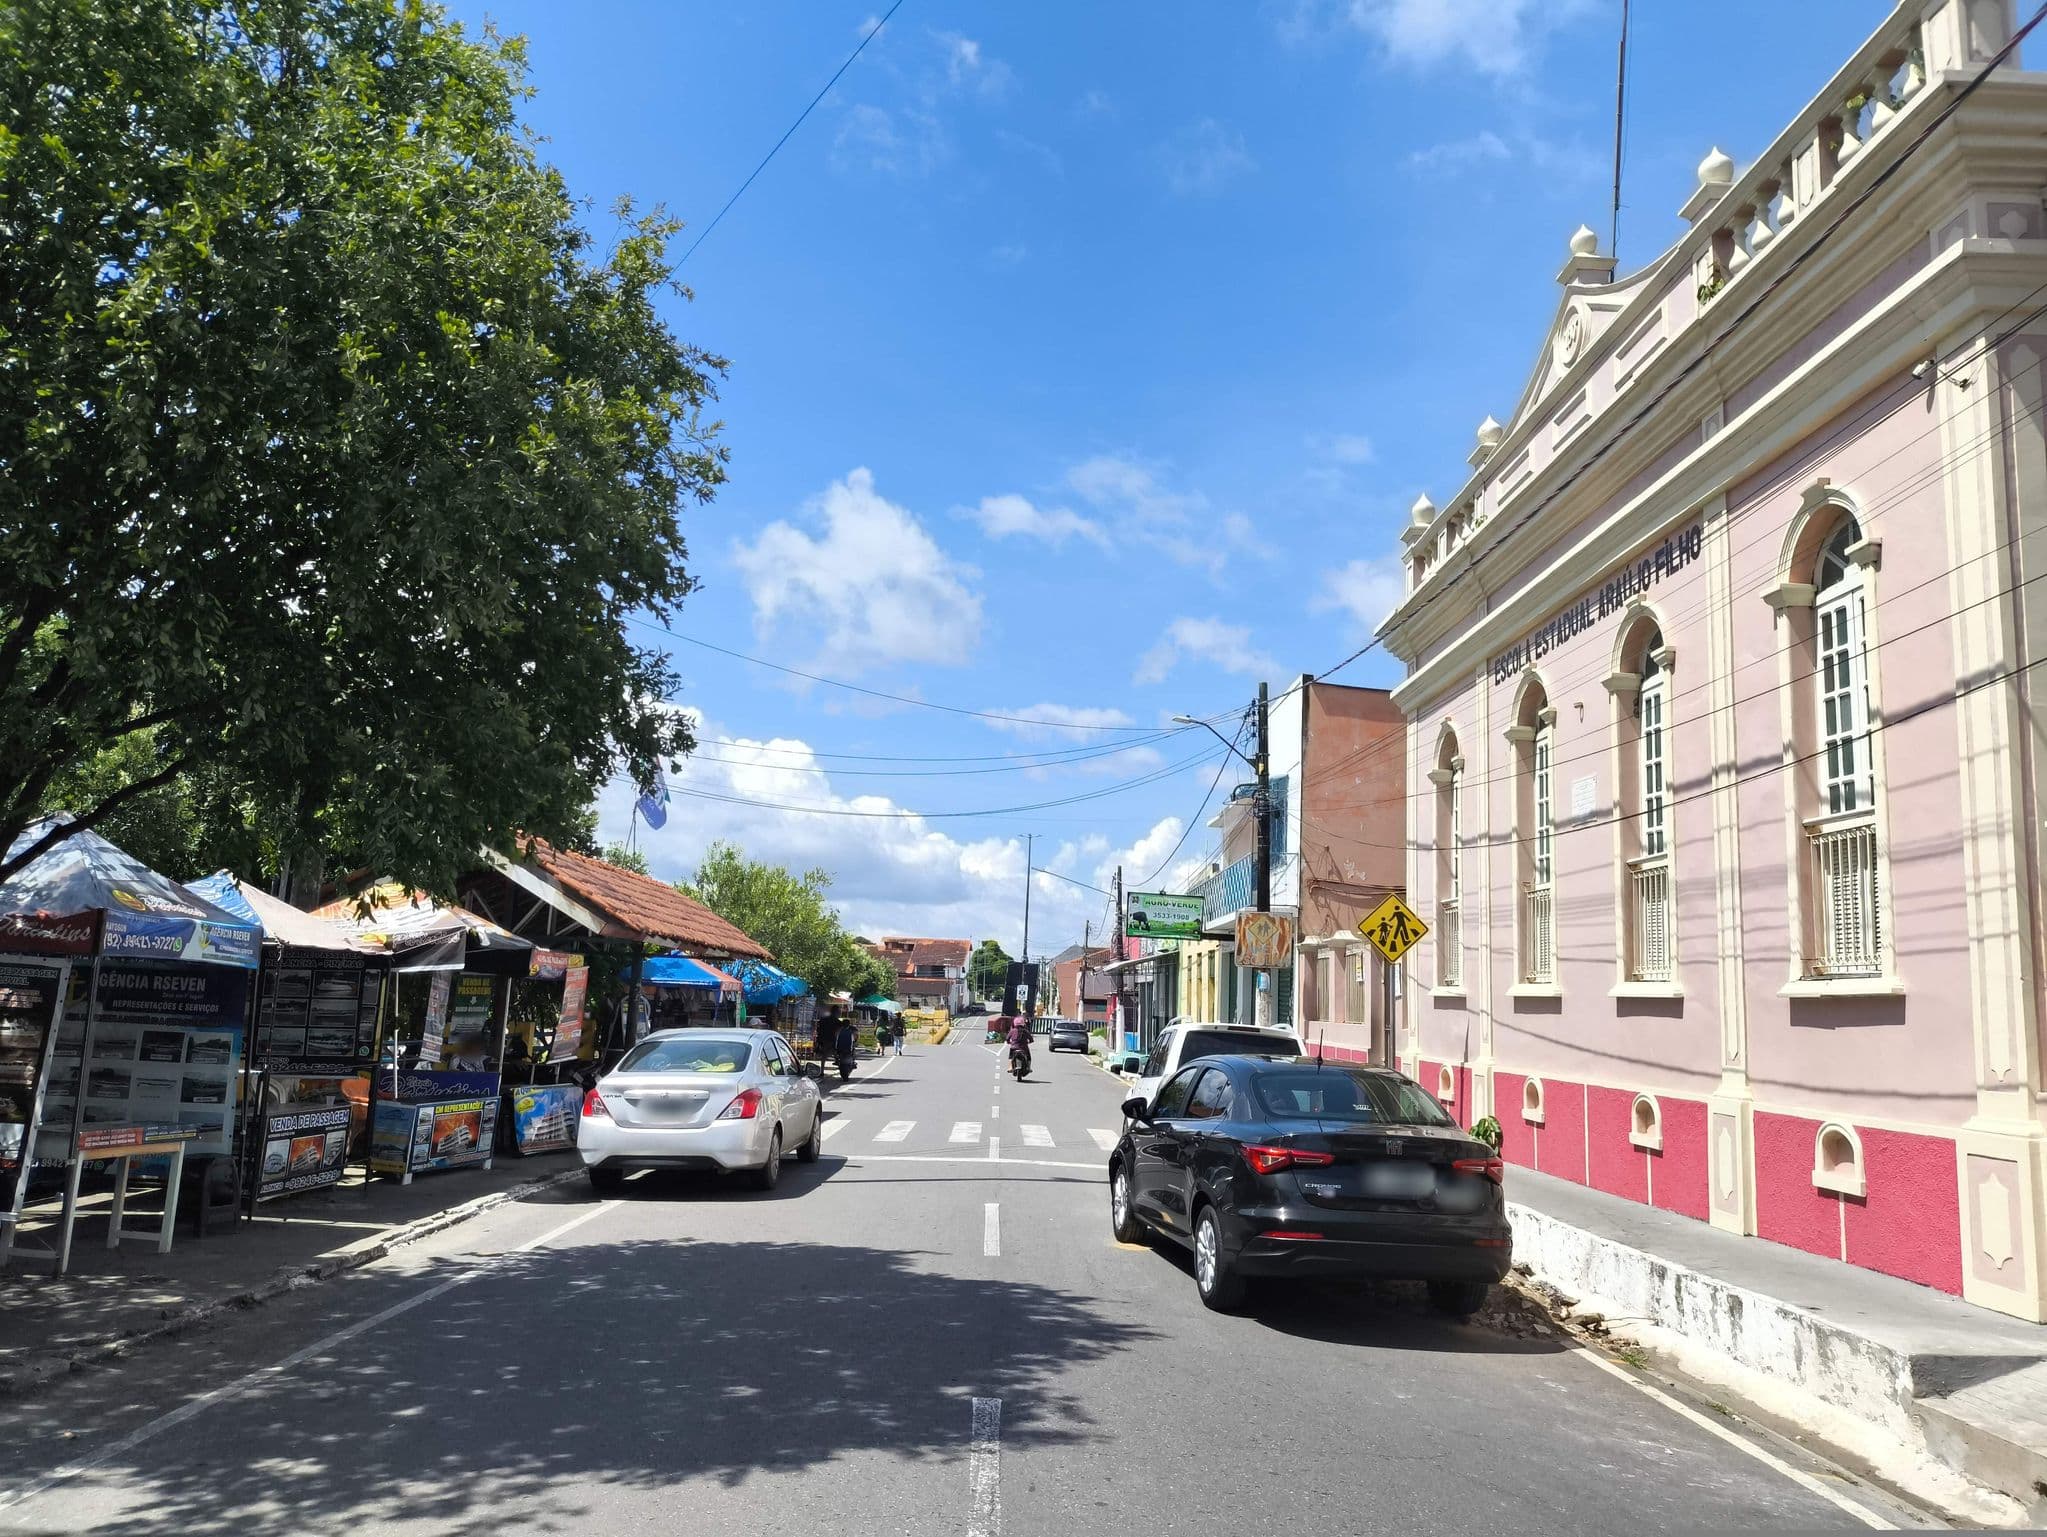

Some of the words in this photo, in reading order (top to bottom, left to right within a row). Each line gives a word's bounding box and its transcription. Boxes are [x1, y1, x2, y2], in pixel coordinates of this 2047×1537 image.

[1494, 639, 1532, 686] ESCOLA
[1534, 598, 1596, 660] ESTADUAL
[1597, 558, 1651, 621] ARAÚJO
[98, 972, 148, 991] GÊNCIA
[152, 975, 207, 992] RSEVEN
[112, 999, 176, 1012] REPRESENTAÇÕES
[178, 1003, 183, 1011] E
[184, 1003, 220, 1014] SERVIÇOS
[269, 1115, 298, 1133] VENDA
[298, 1113, 310, 1130] DE
[310, 1109, 350, 1127] PASSAGEM
